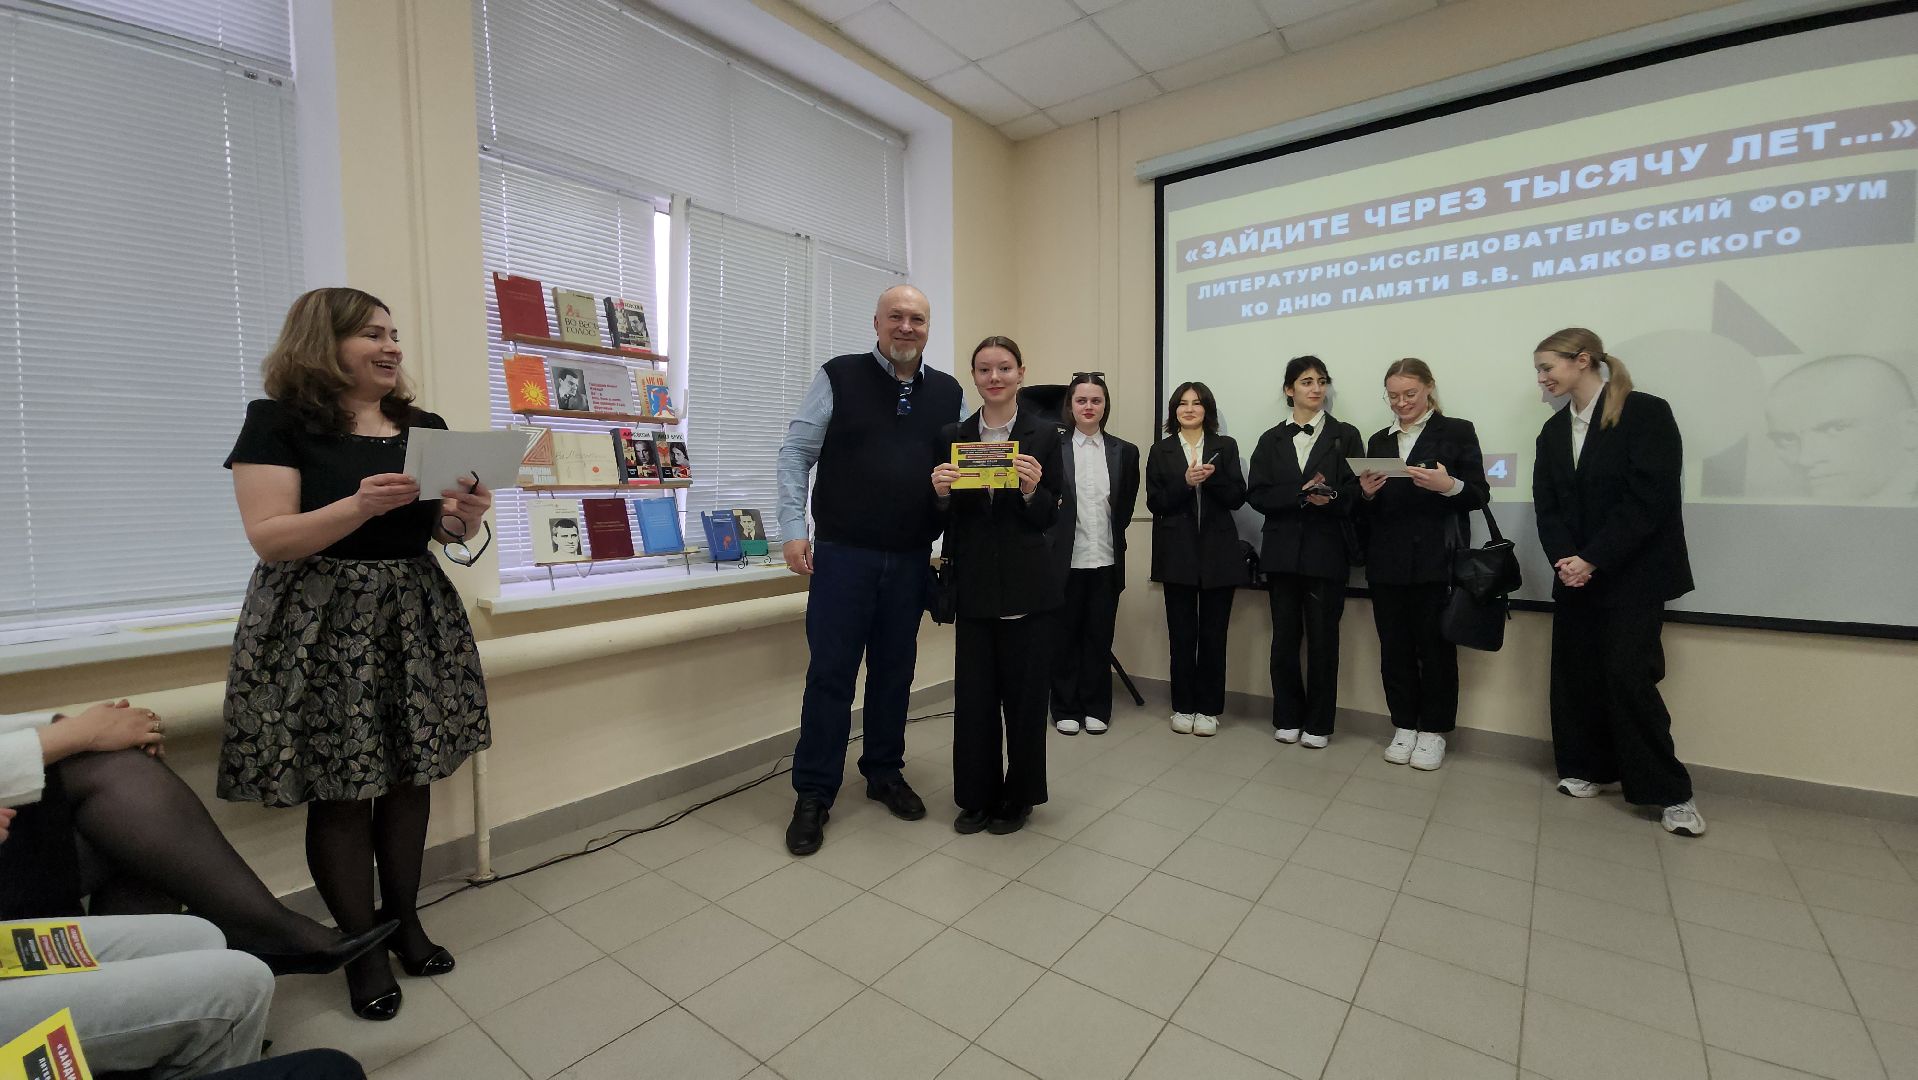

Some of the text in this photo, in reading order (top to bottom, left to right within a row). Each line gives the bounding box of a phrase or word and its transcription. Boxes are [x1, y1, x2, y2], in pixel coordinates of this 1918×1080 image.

[1184, 212, 1350, 263] «ЗАЙДИТЕ
[1364, 186, 1487, 228] ЧЕРЕЗ
[1503, 142, 1709, 203] ТЫСЯЧУ
[1198, 179, 1889, 300] ЛИТЕРАТУРНО-ИССЛЕДОВАТЕЛЬСКИЙ ФОРУМ
[1241, 226, 1802, 318] КО ДНЮ ПАМЯТИ В.В. МАЯКОВСКОГО
